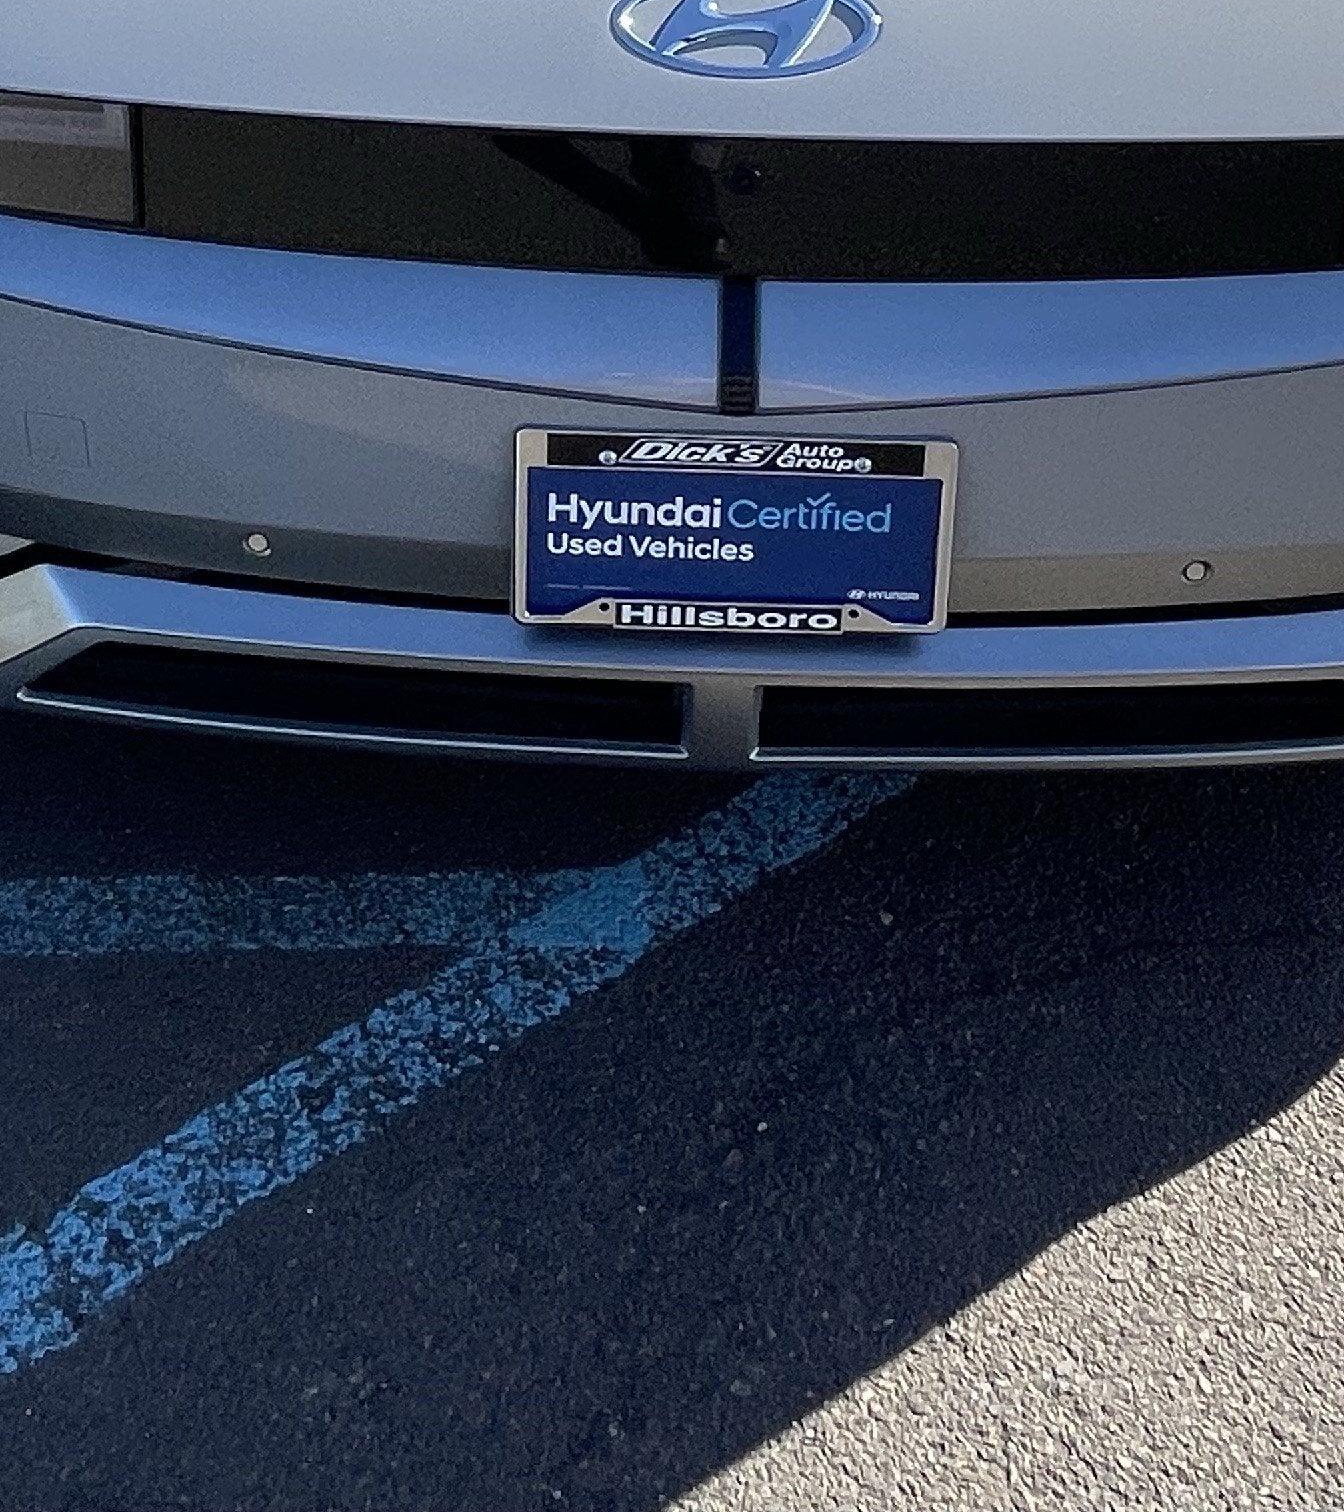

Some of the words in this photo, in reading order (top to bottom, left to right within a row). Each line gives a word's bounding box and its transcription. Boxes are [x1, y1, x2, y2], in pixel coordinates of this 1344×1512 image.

[631, 441, 764, 463] Dick's
[786, 443, 844, 457] Auto
[776, 455, 853, 472] Group
[547, 492, 723, 530] Hyundai
[727, 493, 892, 534] Certified
[546, 533, 624, 557] Used
[629, 535, 755, 561] Vehicles
[620, 604, 837, 629] Hillsboro
